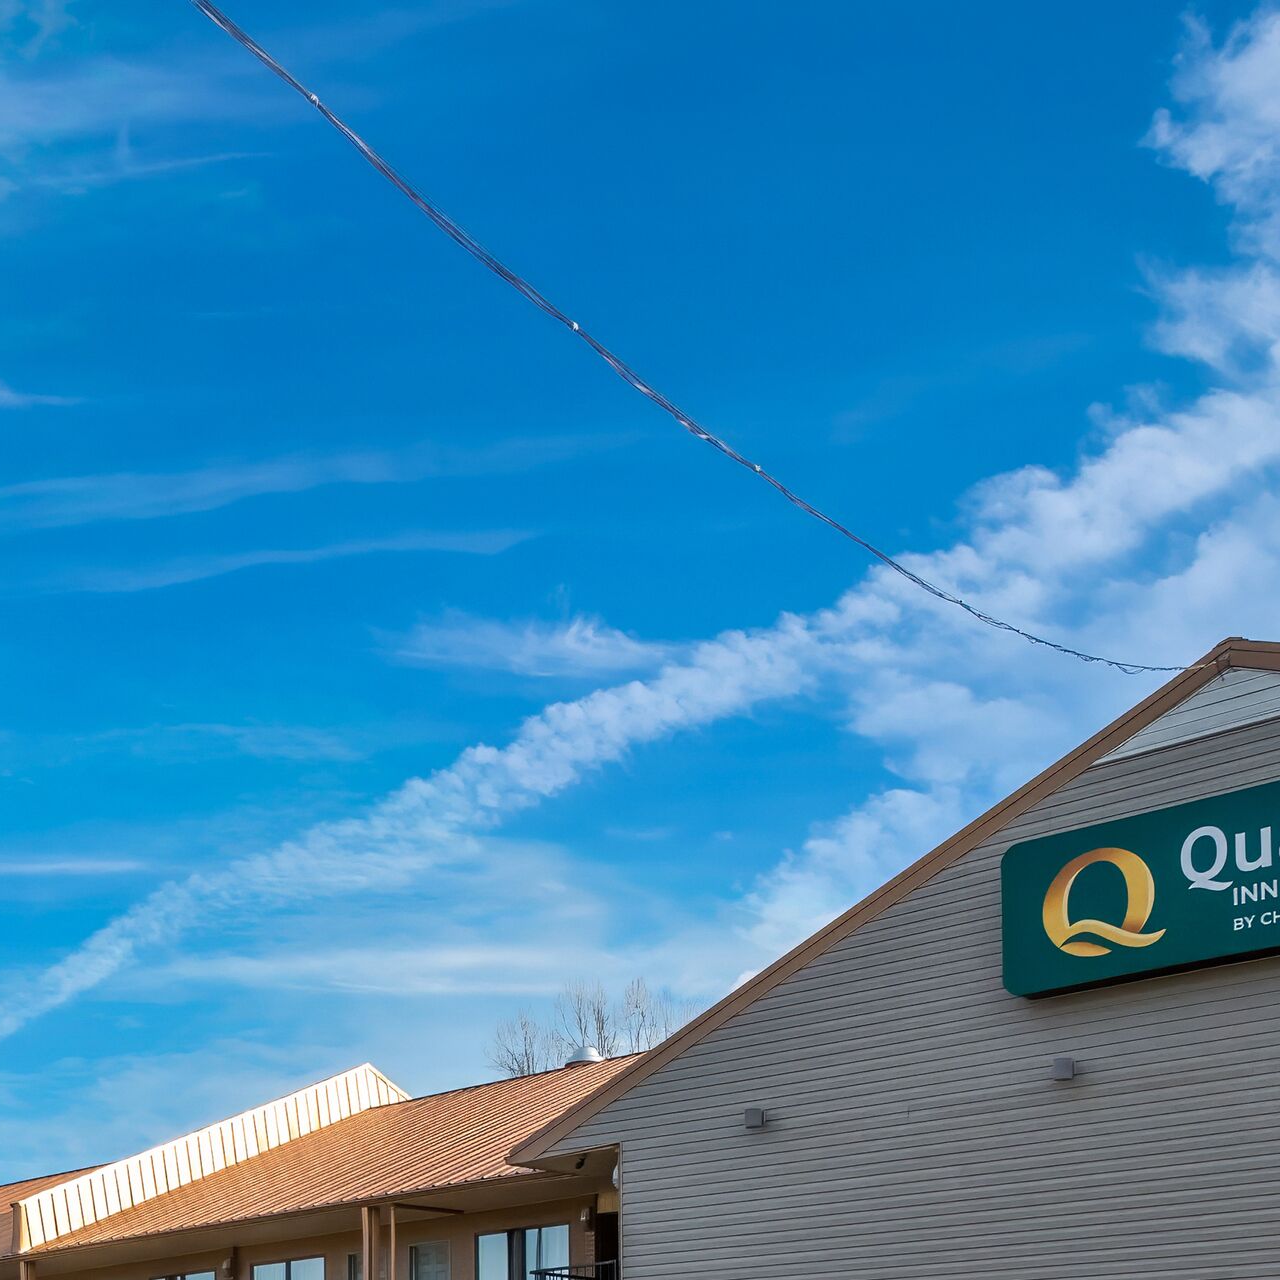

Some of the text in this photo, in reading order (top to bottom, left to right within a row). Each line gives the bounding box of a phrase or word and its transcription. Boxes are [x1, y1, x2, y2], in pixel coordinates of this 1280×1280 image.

[1042, 847, 1167, 958] Q
[1232, 879, 1278, 906] INN
[1233, 915, 1256, 931] BY
